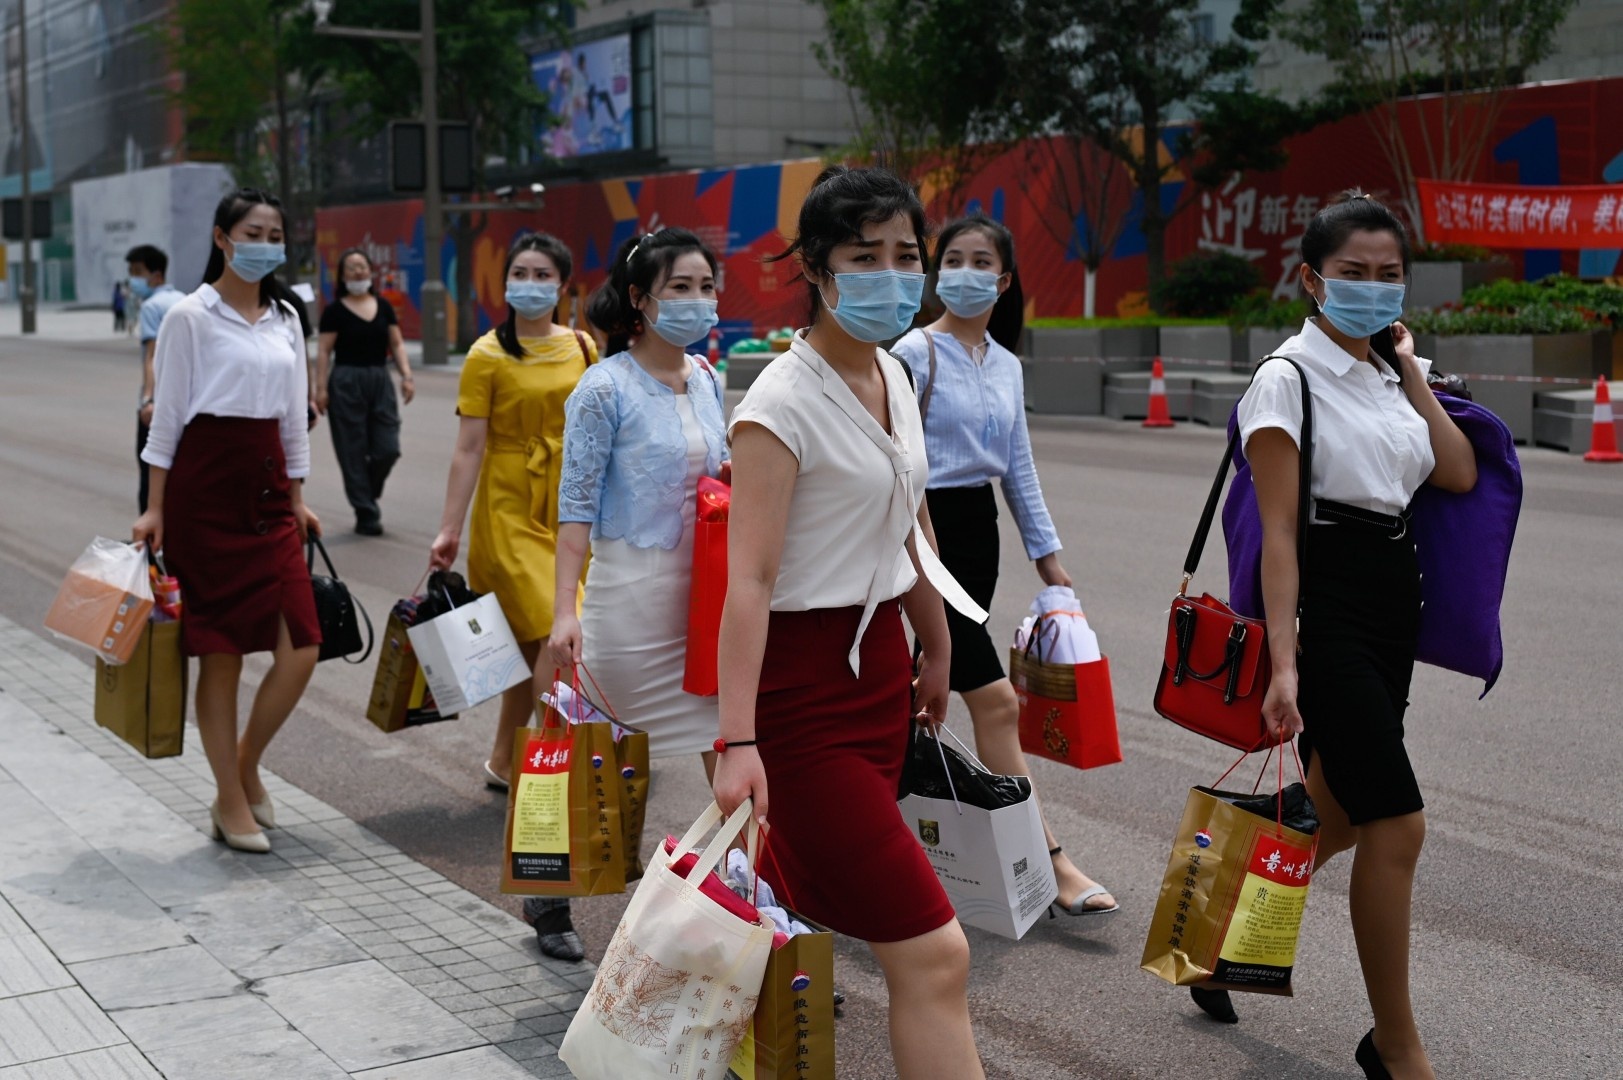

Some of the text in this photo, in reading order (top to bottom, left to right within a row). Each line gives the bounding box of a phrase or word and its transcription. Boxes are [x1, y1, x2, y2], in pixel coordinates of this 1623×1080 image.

[1167, 853, 1201, 949] 过量饮酒有害健康
